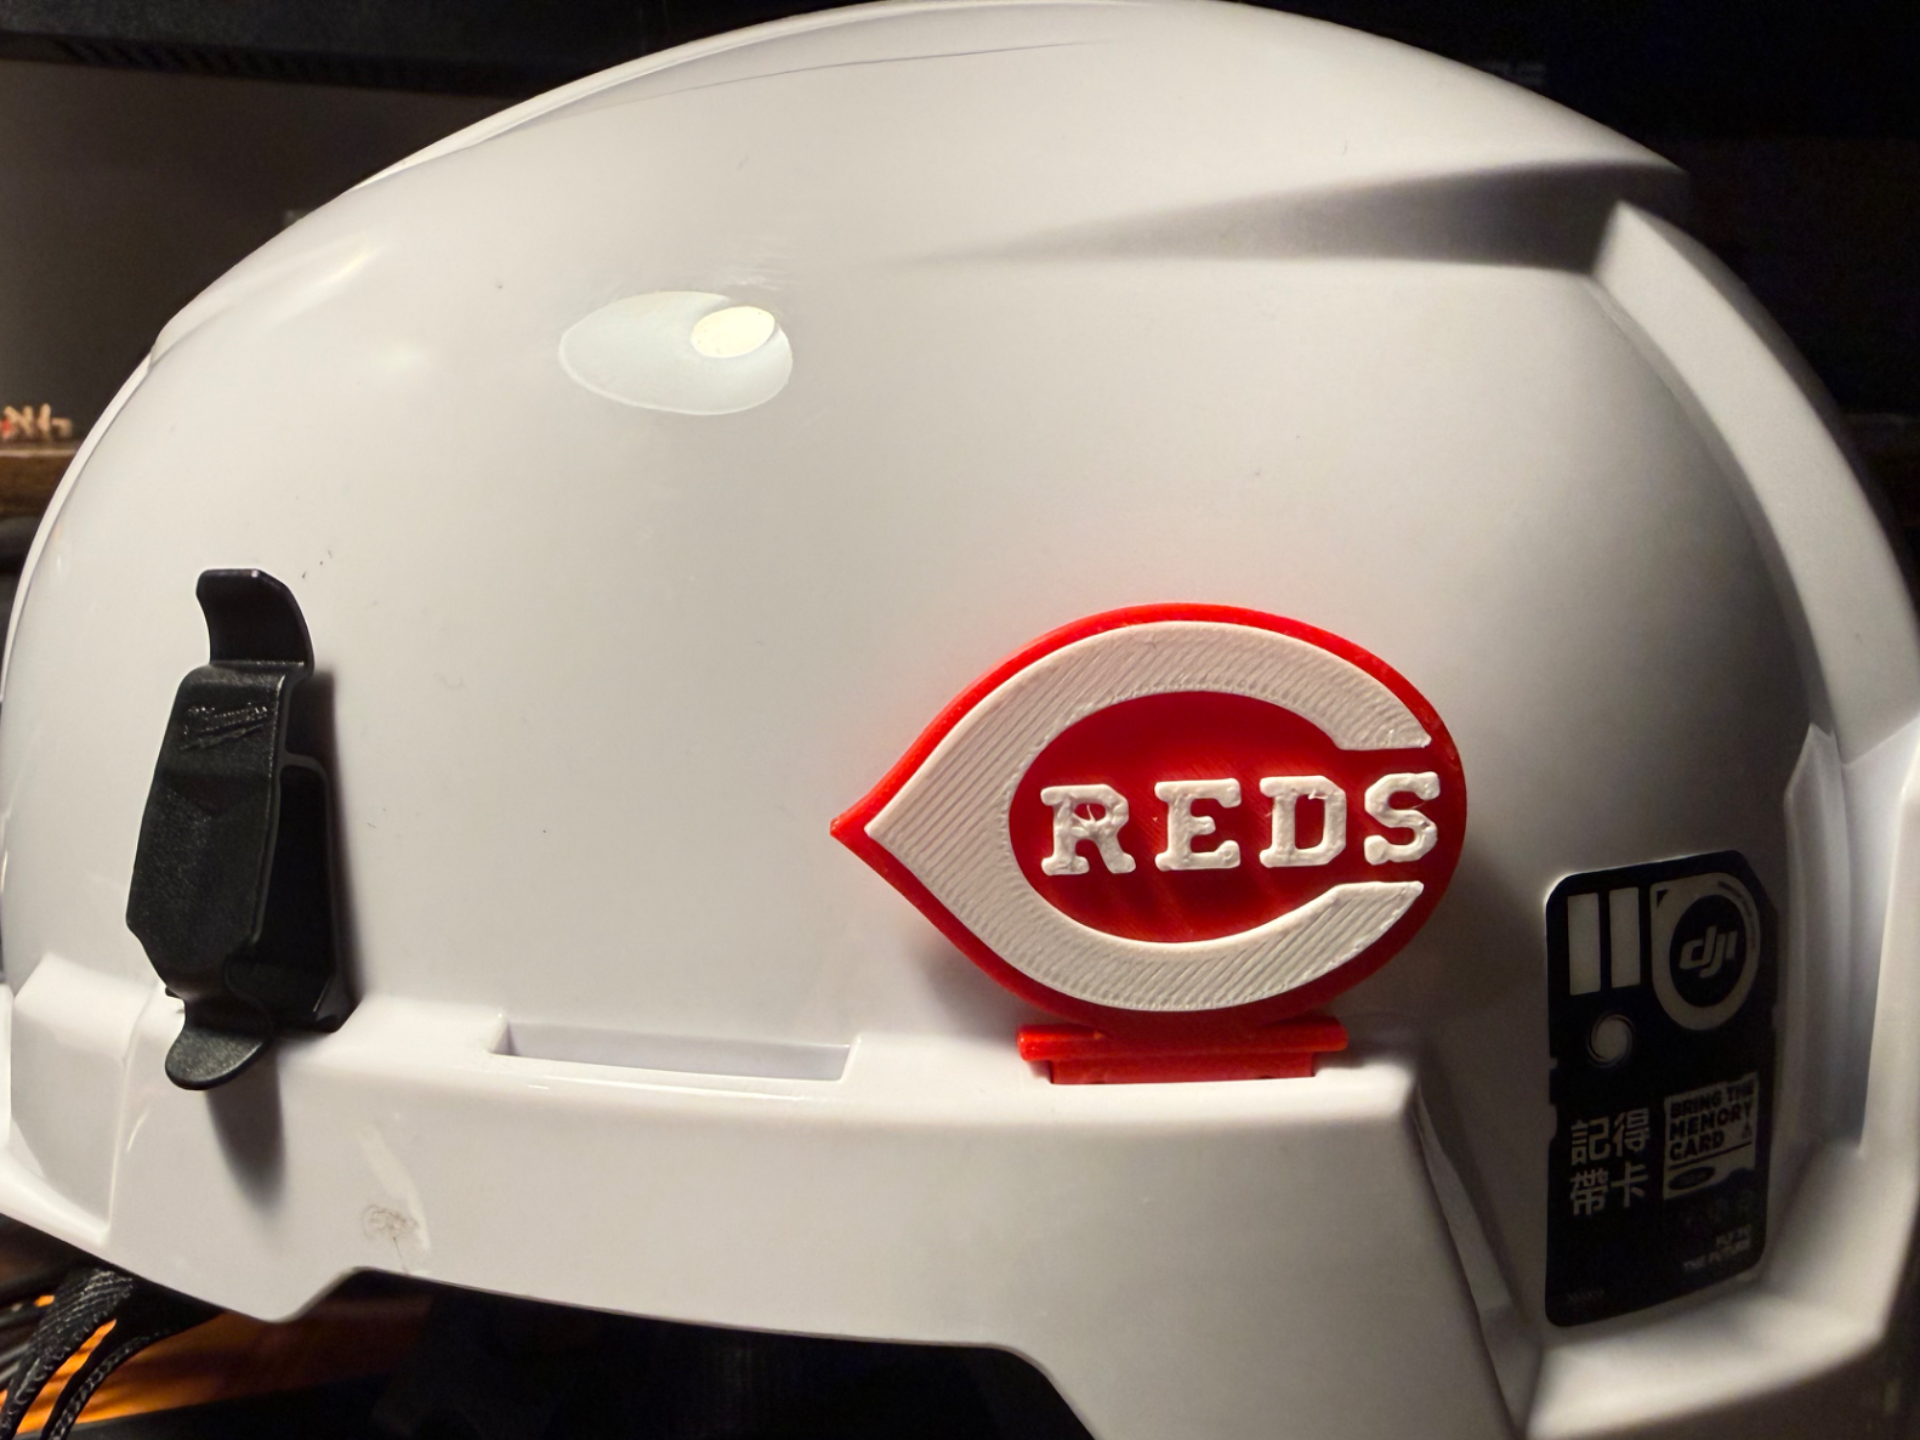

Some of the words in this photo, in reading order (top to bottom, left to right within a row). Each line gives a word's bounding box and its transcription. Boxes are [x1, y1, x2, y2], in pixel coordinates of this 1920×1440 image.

[1040, 771, 1440, 876] REDS
[1669, 1100, 1753, 1140] MEMORY
[1670, 1090, 1722, 1118] BRING
[1726, 1078, 1755, 1102] THE
[1570, 1107, 1649, 1166] 記得
[1669, 1130, 1725, 1161] CARD
[1569, 1161, 1649, 1216] 帶卡
